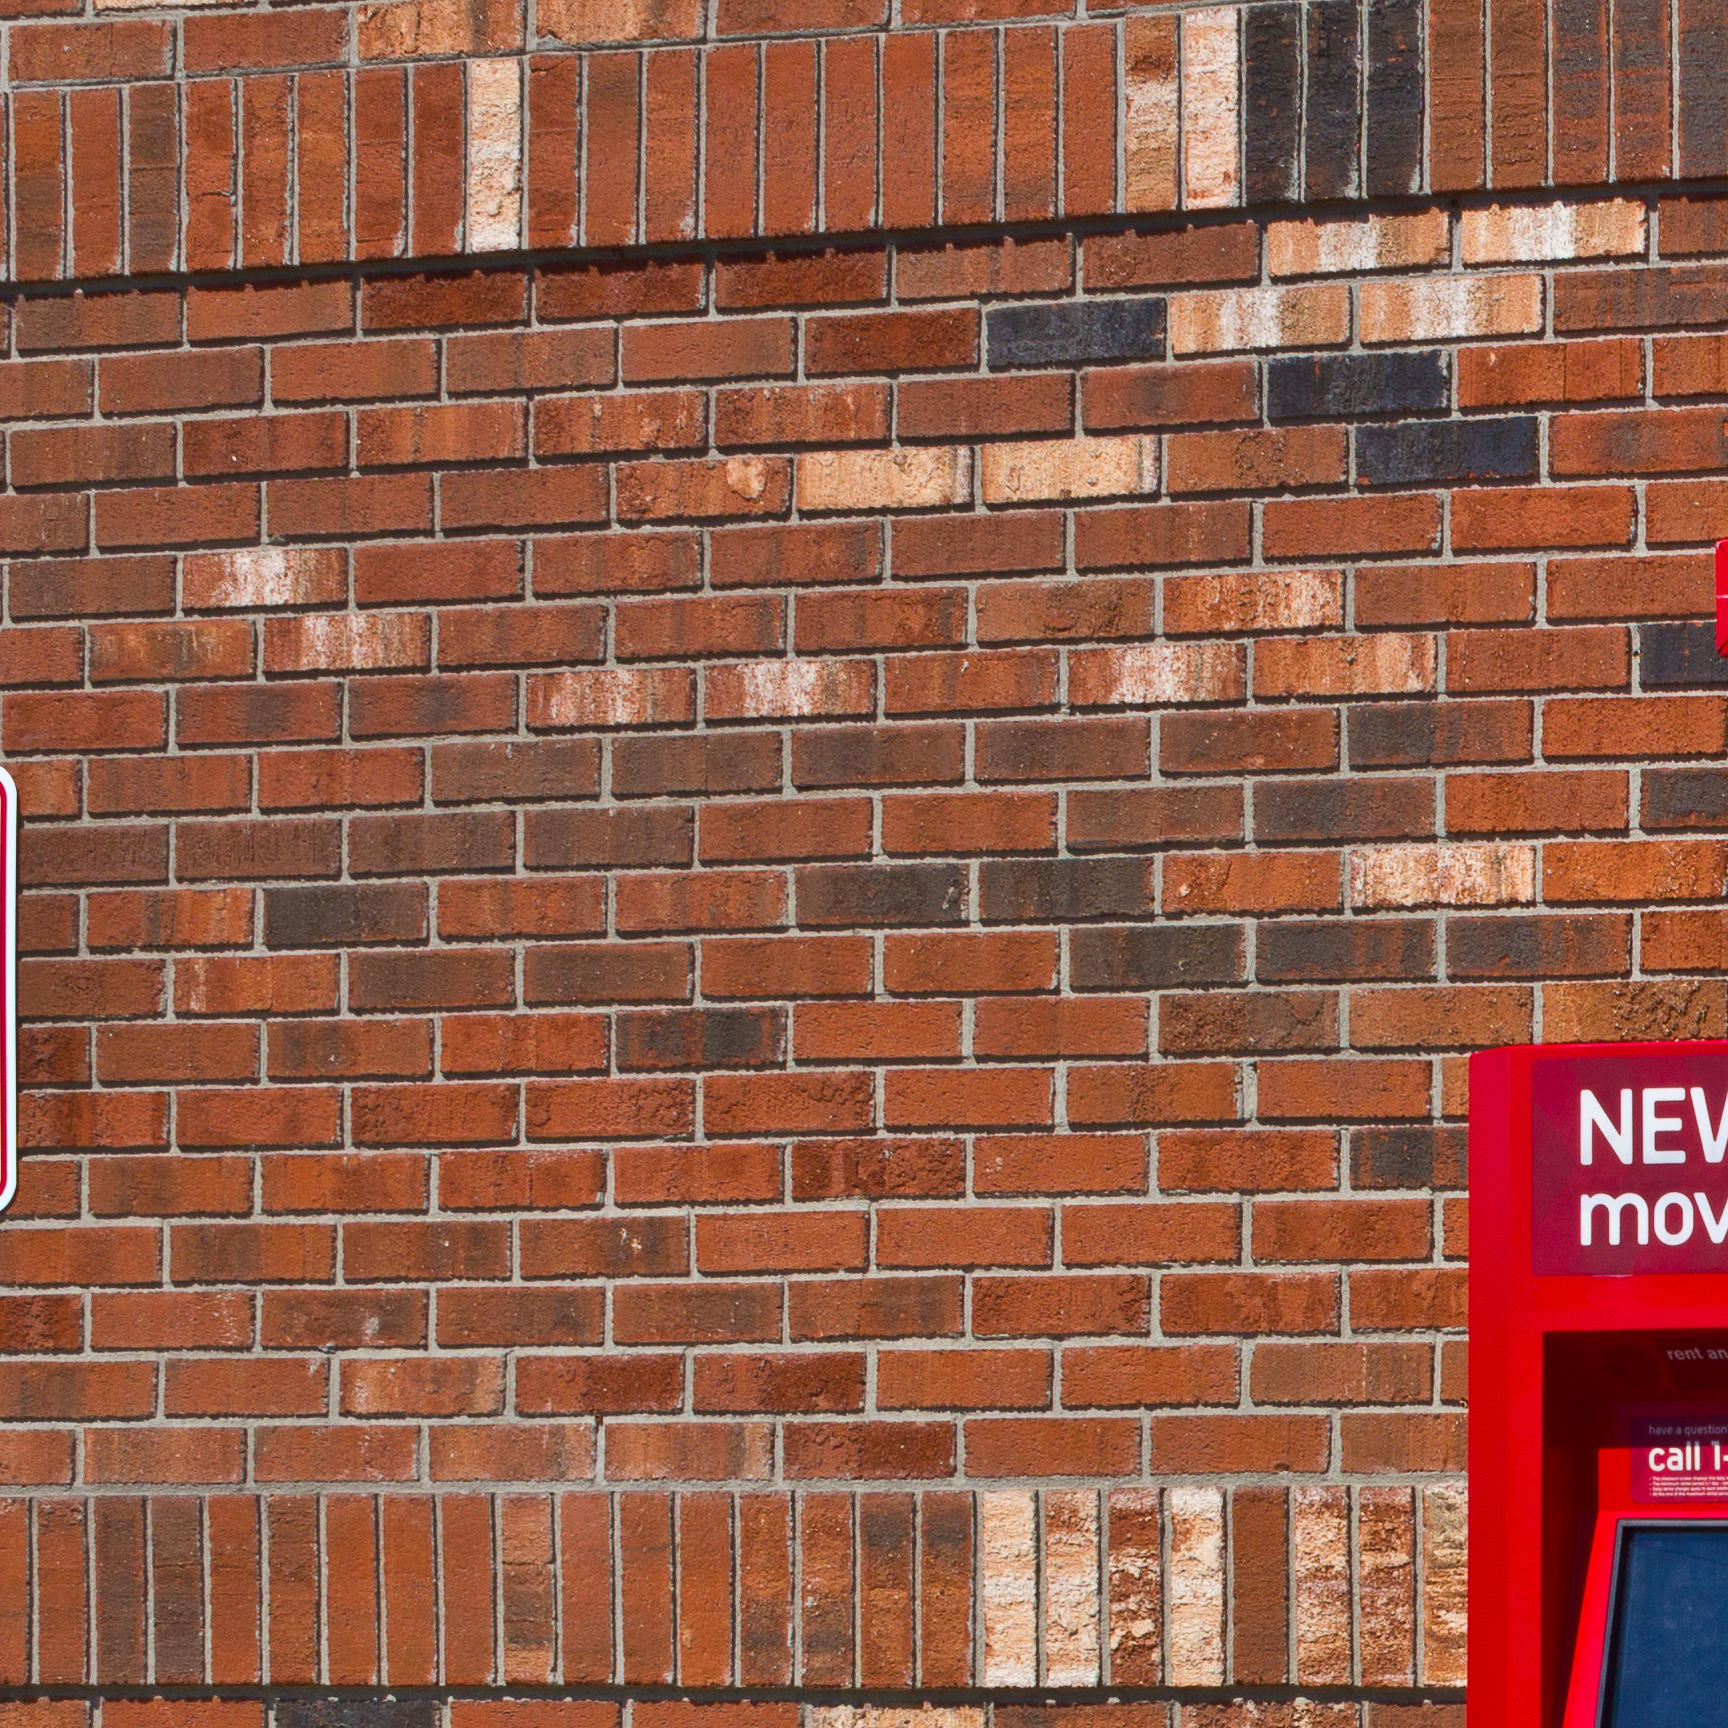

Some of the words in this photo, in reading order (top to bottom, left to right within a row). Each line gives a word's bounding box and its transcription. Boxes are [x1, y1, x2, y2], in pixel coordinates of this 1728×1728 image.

[1667, 1347, 1703, 1361] rent
[1649, 1424, 1673, 1435] have
[1676, 1426, 1682, 1434] a
[1649, 1443, 1700, 1472] call
